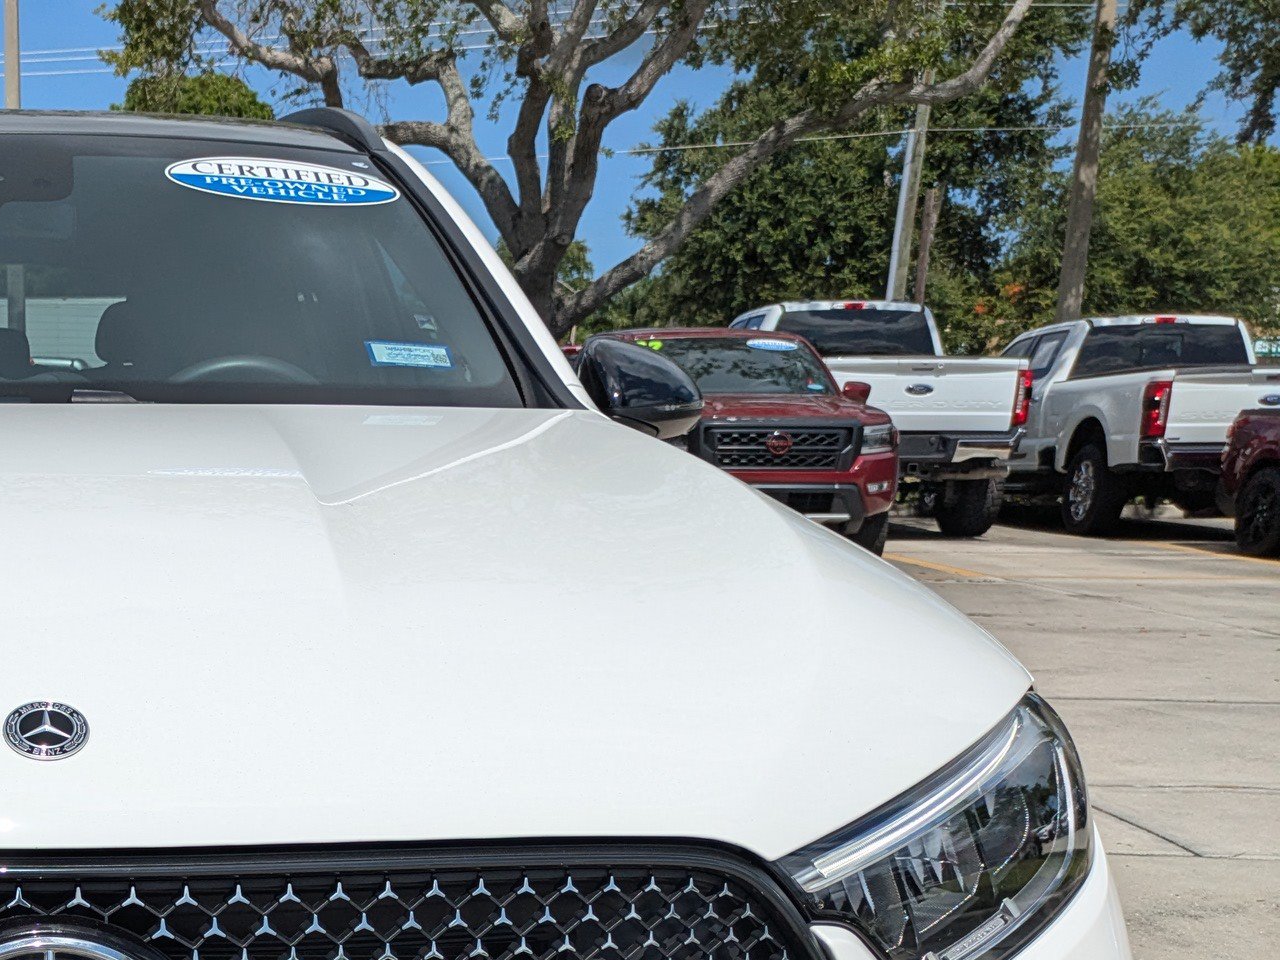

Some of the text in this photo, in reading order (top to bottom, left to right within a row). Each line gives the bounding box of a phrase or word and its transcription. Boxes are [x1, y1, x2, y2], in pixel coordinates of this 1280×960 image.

[191, 162, 370, 188] CERTIFIED
[205, 176, 366, 197] PRE-OWNED
[231, 185, 347, 202] VEHICLE
